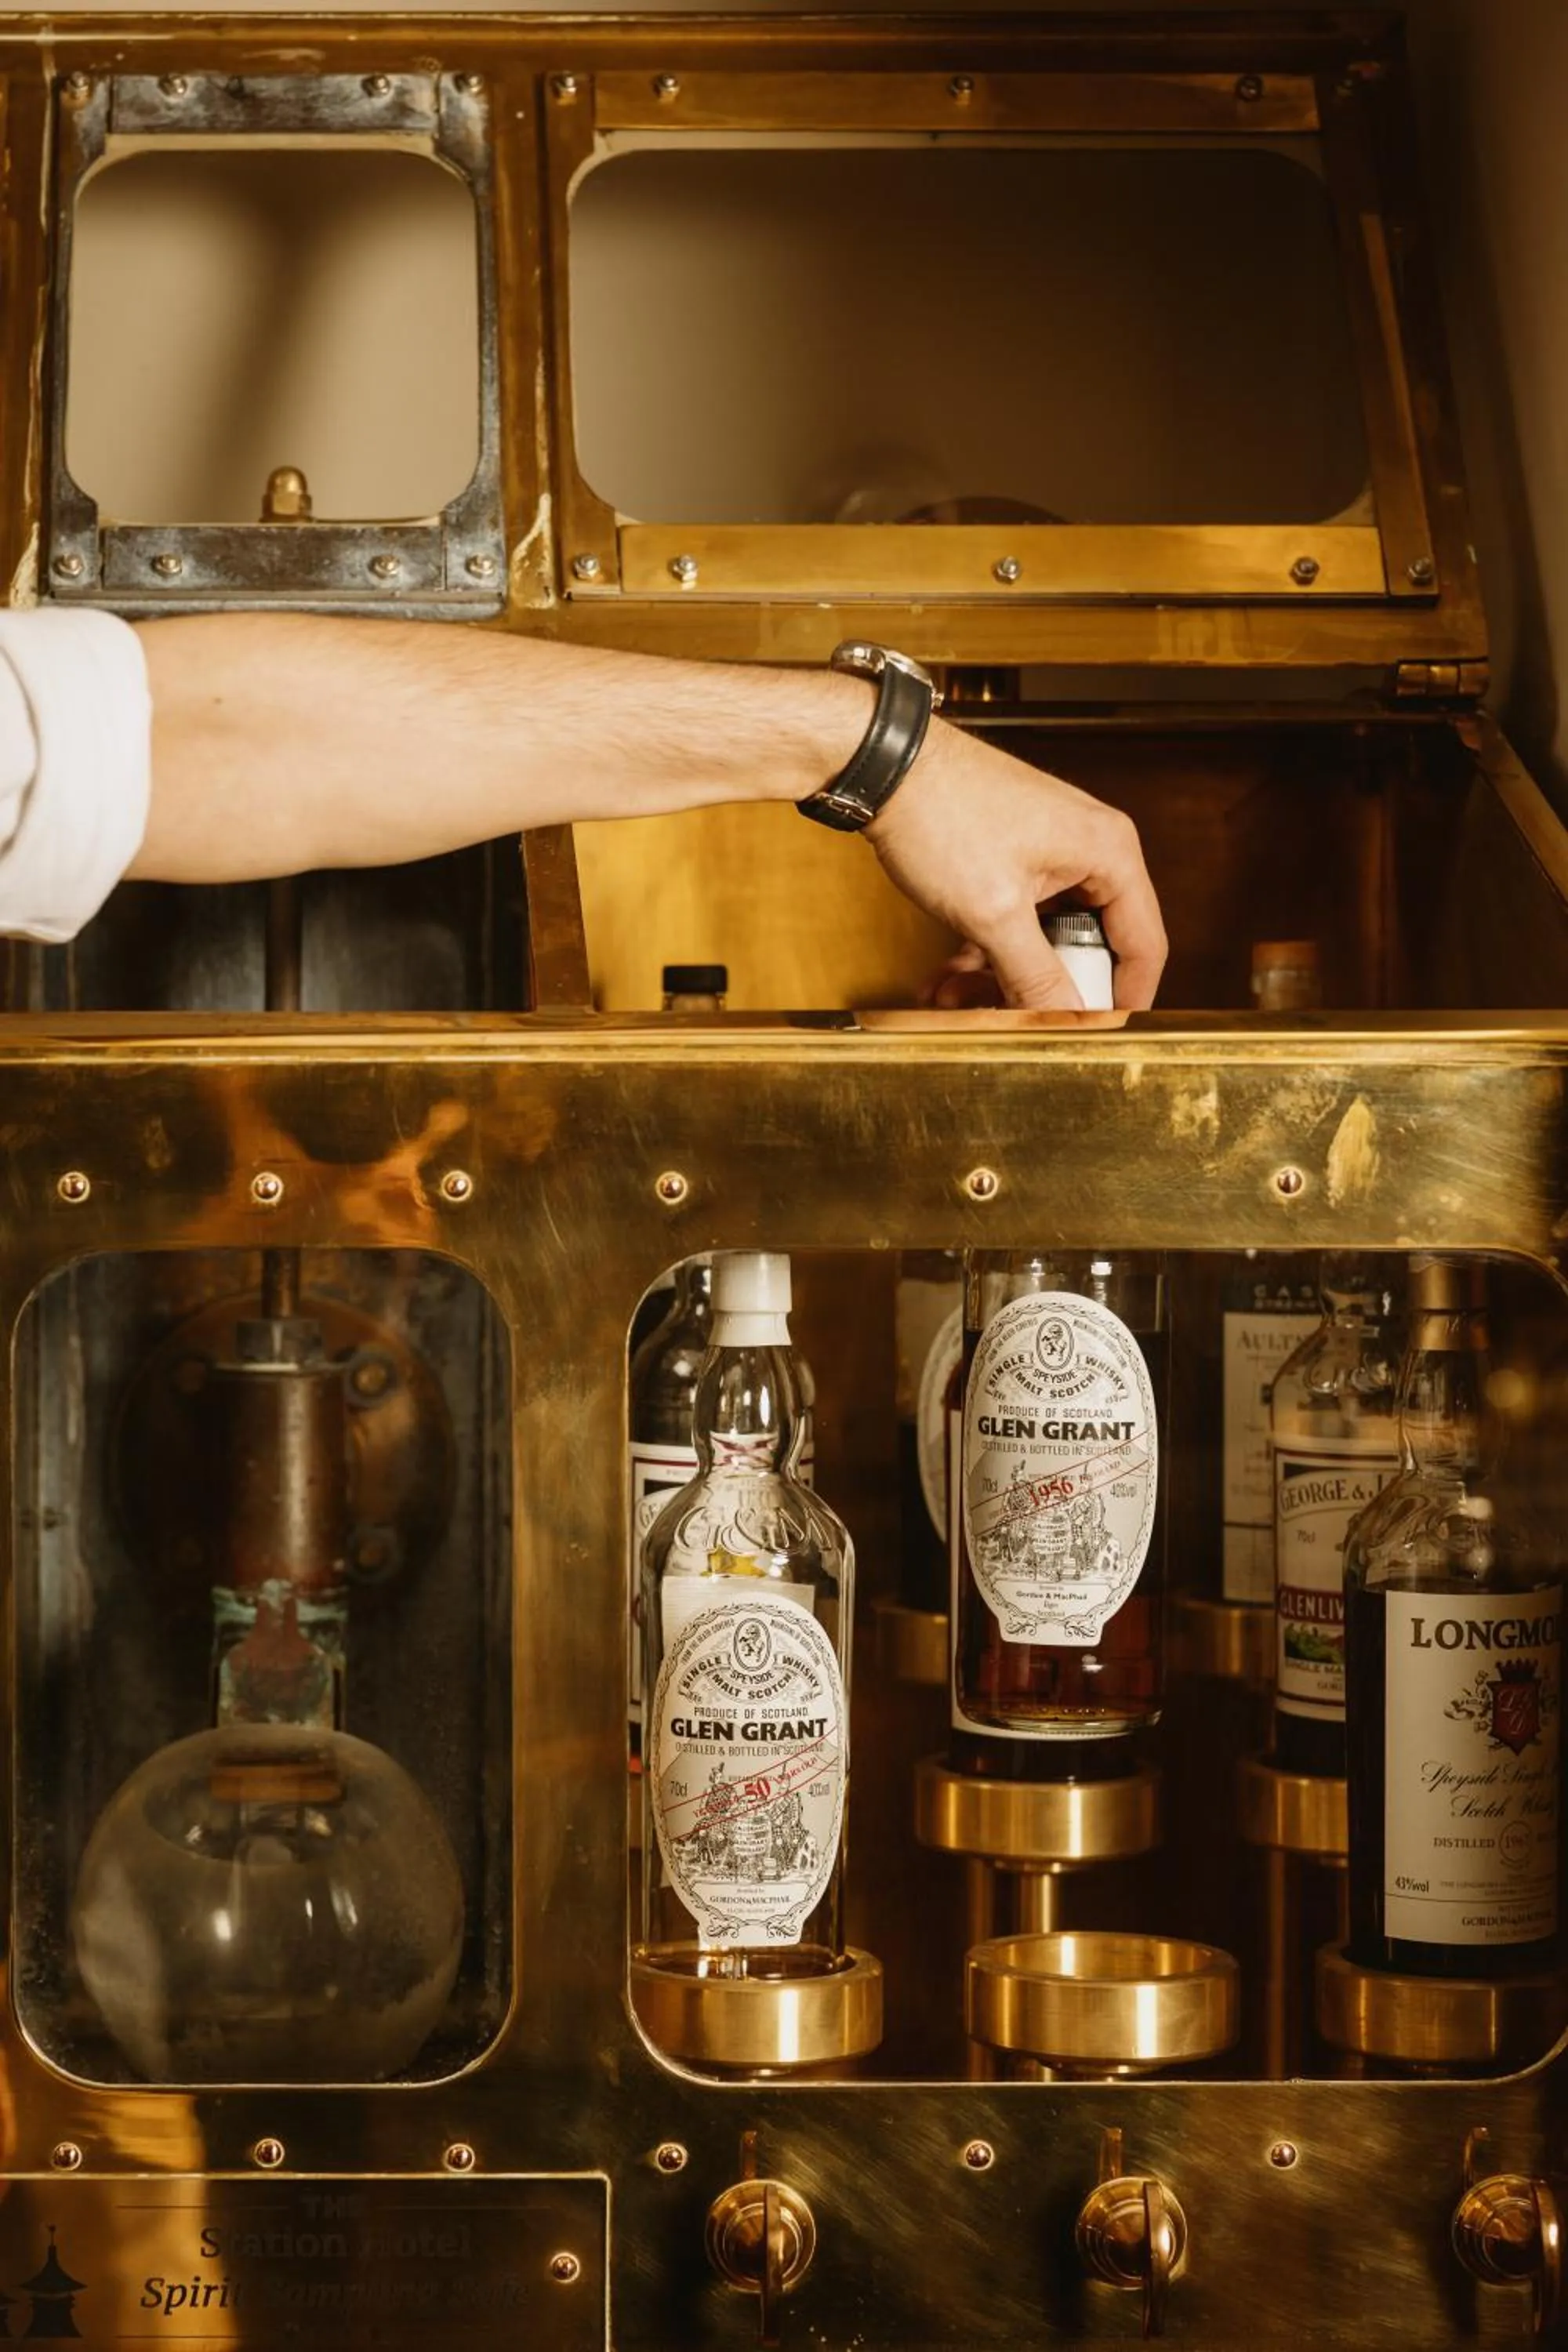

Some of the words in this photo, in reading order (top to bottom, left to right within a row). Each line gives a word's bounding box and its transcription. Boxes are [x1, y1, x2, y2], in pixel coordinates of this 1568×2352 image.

[988, 1353, 1025, 1388] SINGLE
[1033, 1369, 1078, 1384] SPEYSIDE
[1086, 1356, 1125, 1391] WHISKY
[1015, 1372, 1043, 1396] MALT
[1050, 1375, 1096, 1399] SCOTCH
[998, 1405, 1039, 1416] PRODUCE
[1045, 1407, 1057, 1417] OF
[1063, 1408, 1112, 1418] SCOTLAND
[978, 1416, 1036, 1439] GLEN
[1042, 1421, 1135, 1440] GRANT
[1021, 1443, 1026, 1454] &
[1029, 1444, 1069, 1456] BOTTLED
[1072, 1446, 1081, 1456] IN
[1028, 1477, 1073, 1506] 1956
[1279, 1479, 1349, 1512] GEORGE
[1352, 1484, 1365, 1500] &
[1279, 1591, 1344, 1620] GLENLIV
[1411, 1616, 1557, 1650] LONGMO
[683, 1655, 722, 1690] SINGLE
[730, 1670, 775, 1685] SPEYSIDE
[782, 1655, 819, 1688] WHISKY
[712, 1673, 742, 1697] MALT
[748, 1672, 793, 1700] SCOTCH
[694, 1707, 738, 1719] PRODUCE
[744, 1708, 756, 1719] OF
[761, 1707, 808, 1719] SCOTLAND
[670, 1718, 734, 1740] GLEN
[741, 1718, 828, 1741] GRANT
[719, 1746, 725, 1755] &
[728, 1746, 768, 1757] BOTTLED
[771, 1745, 781, 1755] IN
[745, 1777, 771, 1804] 50
[1433, 1837, 1495, 1849] DISTILLED
